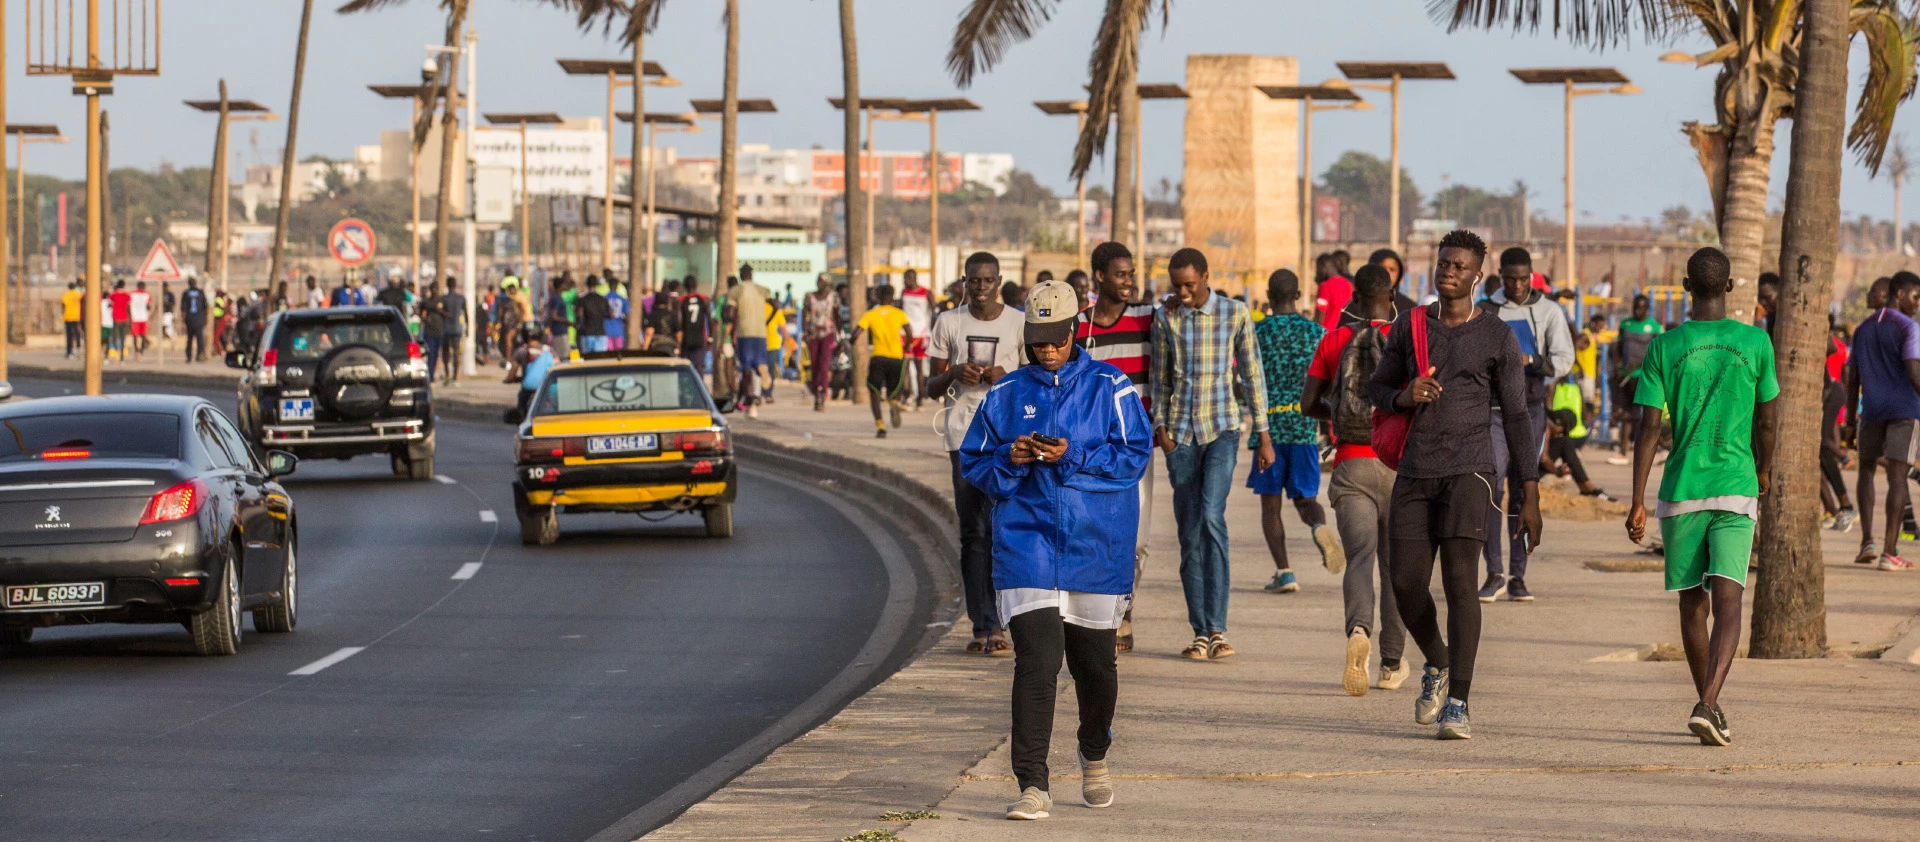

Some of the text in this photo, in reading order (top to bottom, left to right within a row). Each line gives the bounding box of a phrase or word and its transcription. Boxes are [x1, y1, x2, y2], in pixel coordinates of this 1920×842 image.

[688, 304, 700, 323] 7
[1673, 343, 1749, 369] www.tri-cup-bs-land.de
[638, 435, 652, 448] AP
[528, 467, 545, 480] 10
[12, 587, 44, 603] BJL
